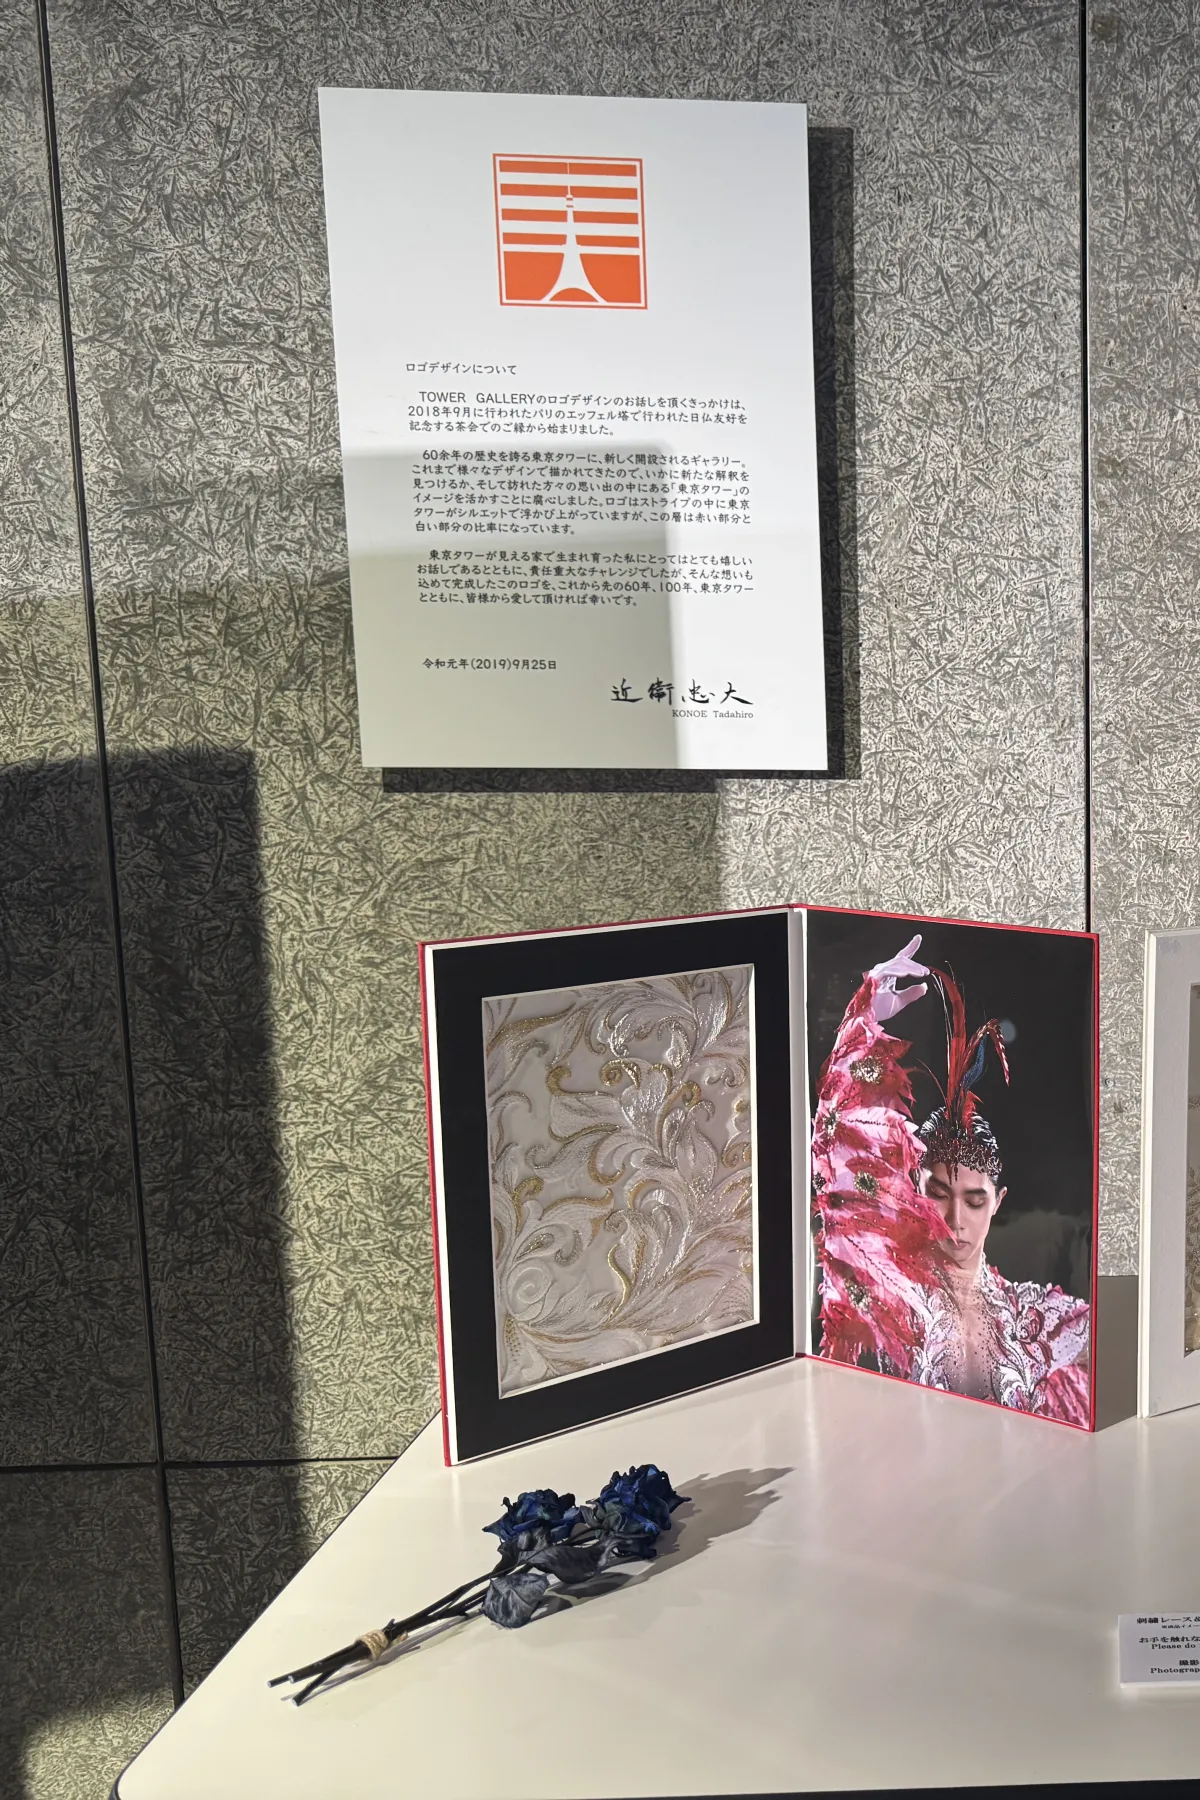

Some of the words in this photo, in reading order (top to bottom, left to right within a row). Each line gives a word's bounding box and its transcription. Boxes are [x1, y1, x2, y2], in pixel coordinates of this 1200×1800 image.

[405, 361, 517, 376] ロゴデザインについて
[418, 391, 467, 403] TOWER
[415, 520, 575, 536] 白い部分の比率になっています。
[671, 709, 708, 718] KONOE
[712, 710, 754, 719] Tadahiro
